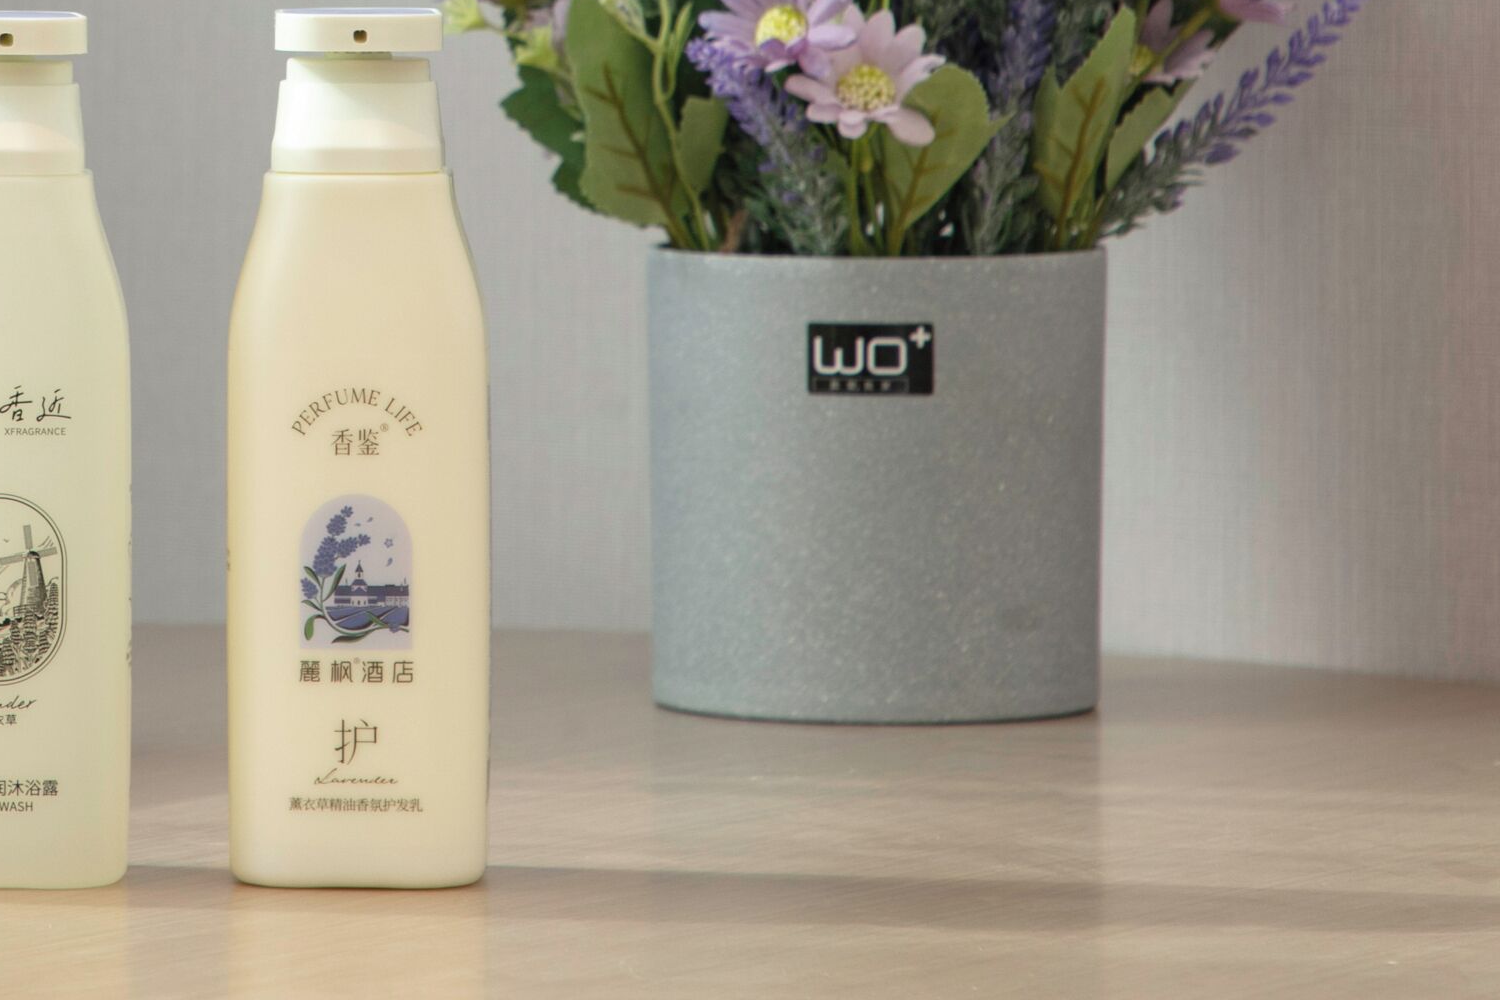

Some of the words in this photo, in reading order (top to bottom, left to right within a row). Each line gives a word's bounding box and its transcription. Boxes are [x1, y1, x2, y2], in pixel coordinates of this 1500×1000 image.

[291, 387, 381, 436] PERFUME
[384, 397, 423, 437] LIFE
[4, 427, 66, 436] XFRAGRANCE
[333, 718, 378, 765] 护
[0, 801, 34, 812] WASH
